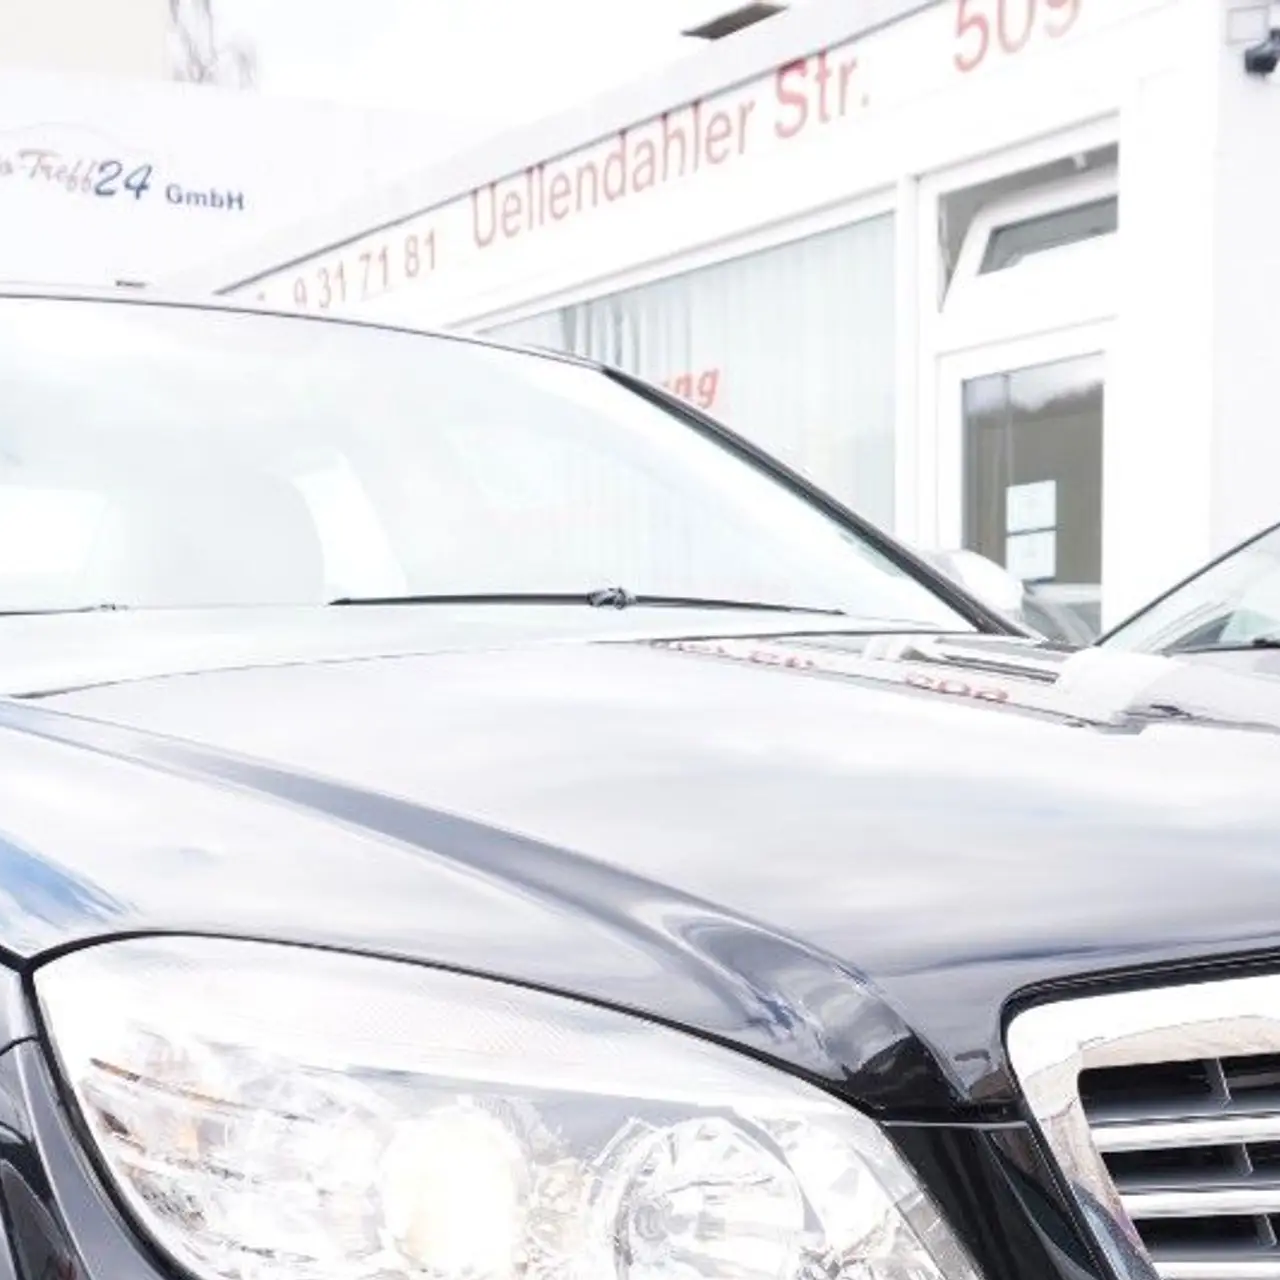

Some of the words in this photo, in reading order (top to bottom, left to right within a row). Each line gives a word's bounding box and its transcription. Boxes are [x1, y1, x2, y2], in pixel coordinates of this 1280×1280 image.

[165, 183, 245, 210] GmbH
[469, 98, 756, 249] Uellendahler
[773, 48, 871, 138] Str.
